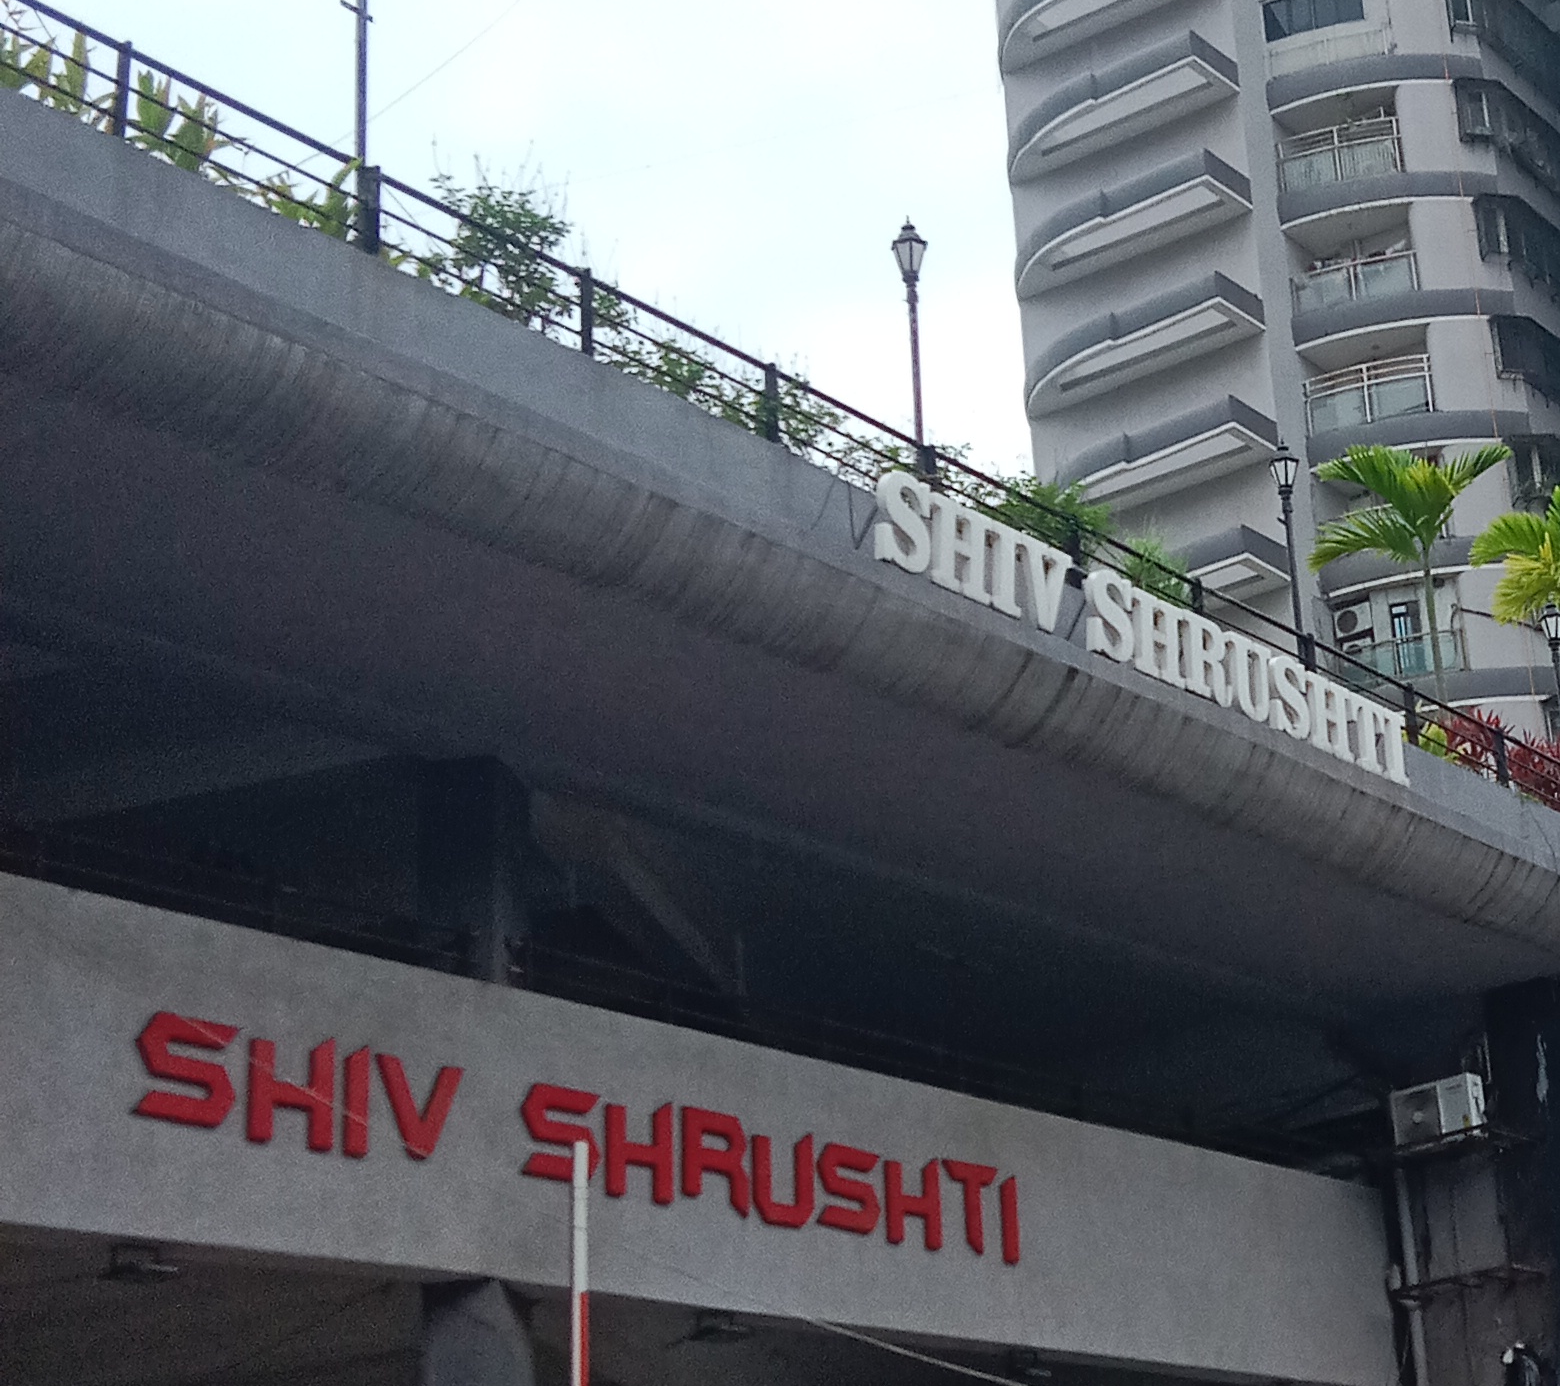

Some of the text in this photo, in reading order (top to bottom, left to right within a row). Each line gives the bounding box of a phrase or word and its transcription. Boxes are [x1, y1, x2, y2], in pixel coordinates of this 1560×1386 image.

[874, 470, 1410, 787] SHIV SHRUSHTI
[132, 1012, 1021, 1266] SHIV SHRUSHTI
